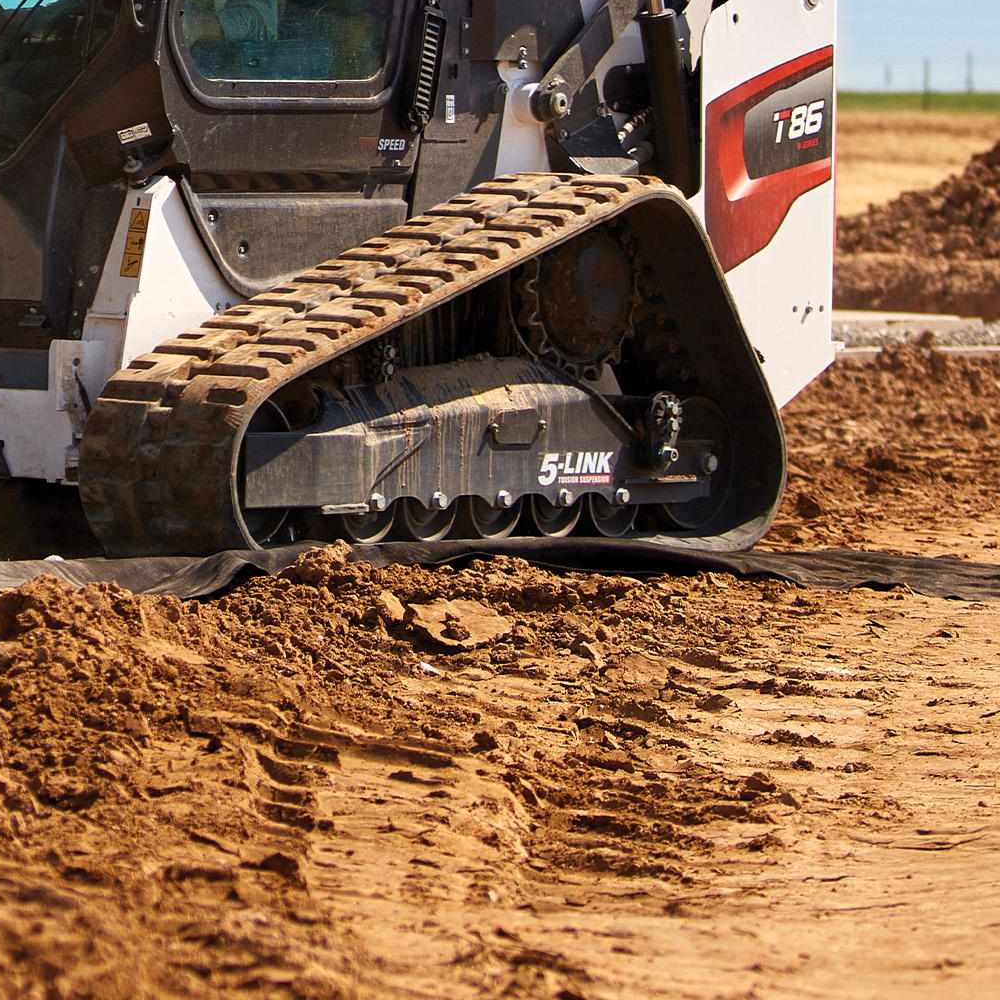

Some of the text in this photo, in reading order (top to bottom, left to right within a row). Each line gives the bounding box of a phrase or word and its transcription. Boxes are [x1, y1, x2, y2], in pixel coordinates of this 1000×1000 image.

[773, 99, 825, 144] T86
[378, 138, 406, 151] SPEED
[538, 451, 614, 486] 5-LINK
[579, 475, 609, 484] SUSPENSION
